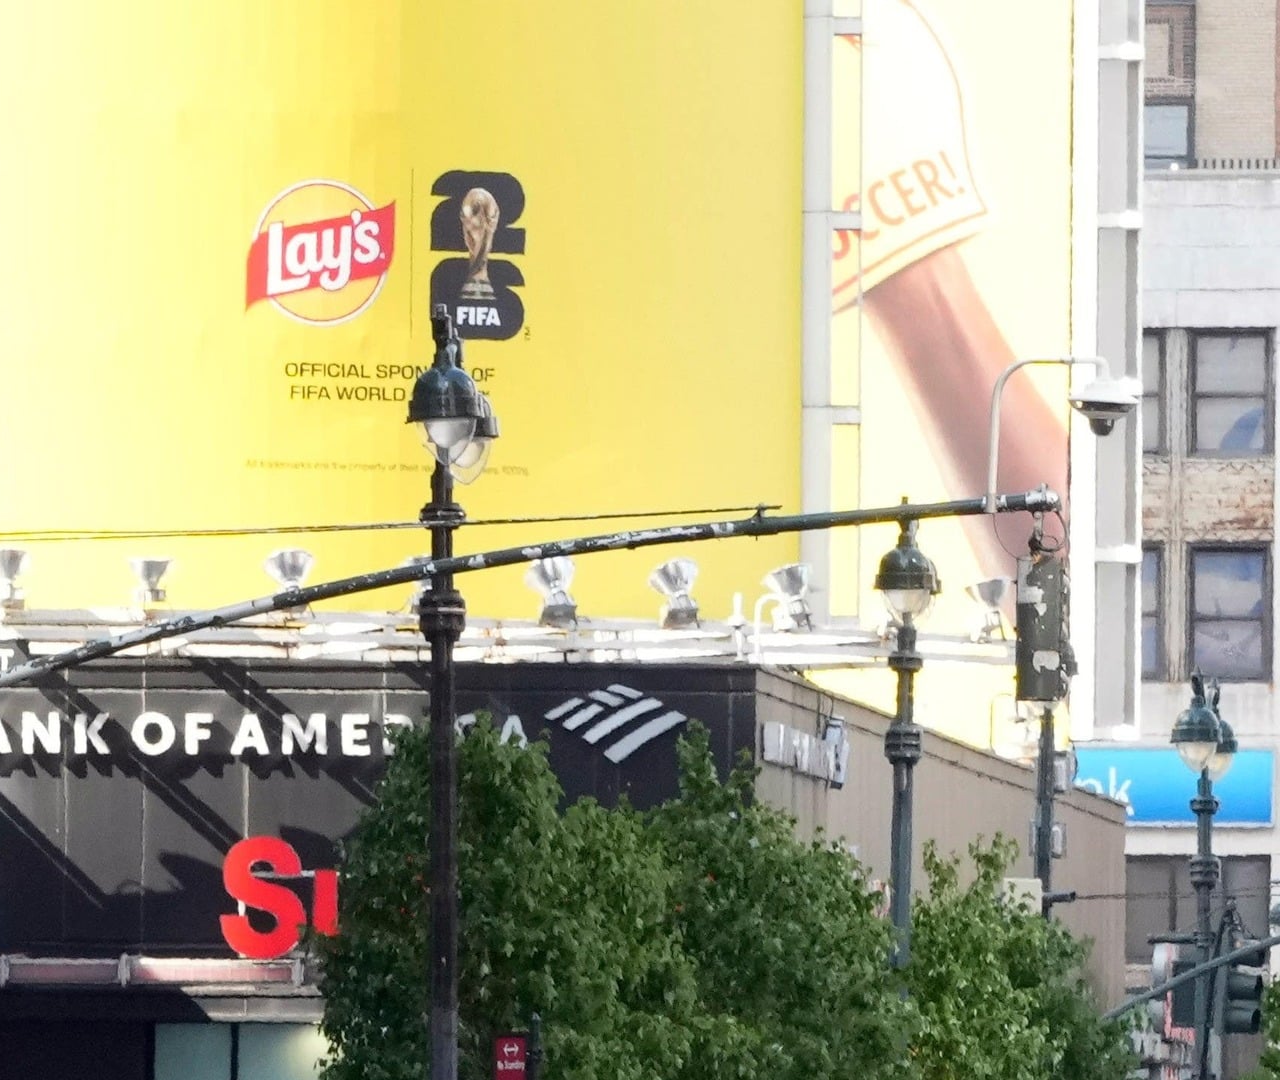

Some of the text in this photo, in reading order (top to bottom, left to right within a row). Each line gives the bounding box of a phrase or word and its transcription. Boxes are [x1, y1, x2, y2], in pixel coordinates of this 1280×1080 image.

[456, 306, 501, 327] FIFA
[284, 362, 495, 382] OFFICIAL SPON OF
[290, 385, 406, 402] FIFA WORLD
[130, 711, 214, 756] OF
